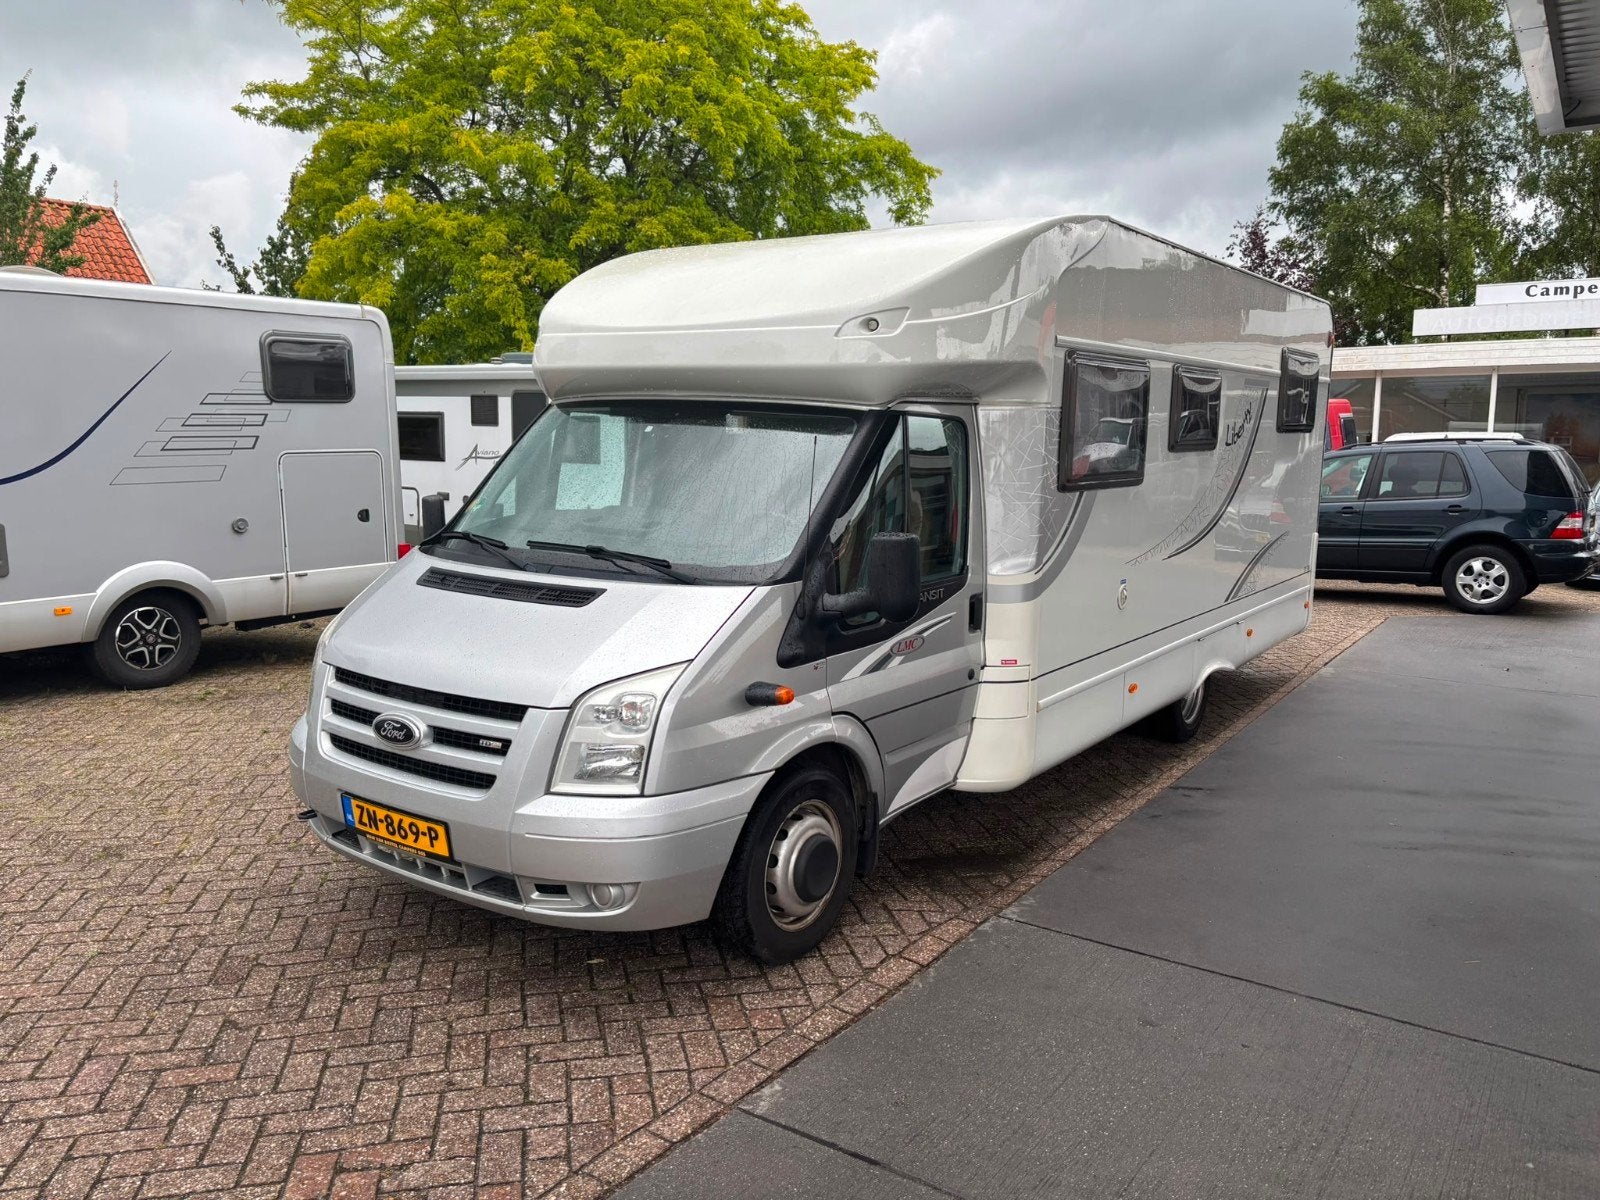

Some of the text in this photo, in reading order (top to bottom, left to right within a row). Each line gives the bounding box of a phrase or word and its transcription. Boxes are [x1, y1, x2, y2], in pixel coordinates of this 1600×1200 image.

[1525, 284, 1598, 299] Campe
[1225, 401, 1252, 446] Liberty
[455, 443, 502, 471] Aviano
[920, 588, 944, 602] ANSIT
[896, 638, 919, 652] LMC
[380, 720, 407, 740] Ford
[355, 803, 439, 848] ZN-869-P
